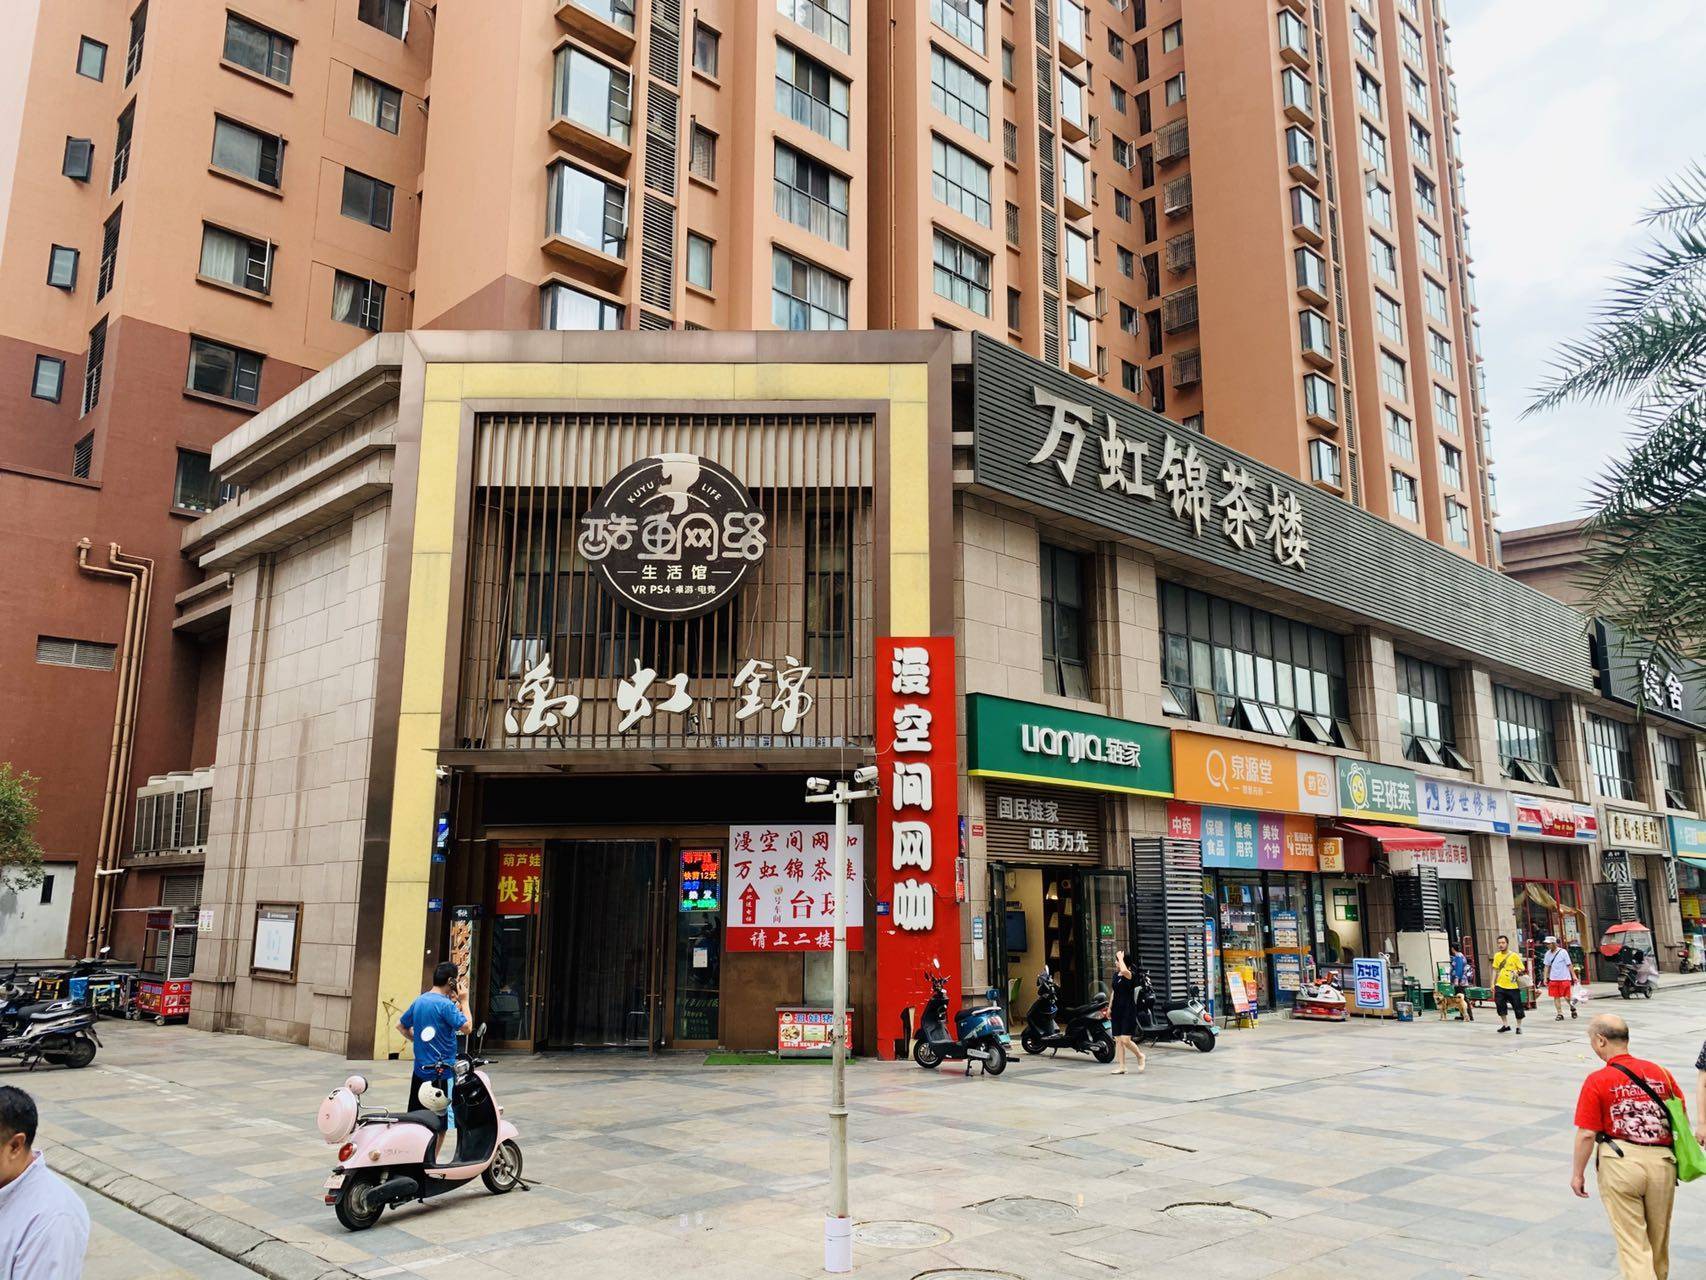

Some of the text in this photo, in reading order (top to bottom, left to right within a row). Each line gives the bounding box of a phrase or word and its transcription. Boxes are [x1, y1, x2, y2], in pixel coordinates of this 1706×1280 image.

[1026, 385, 1310, 571] 万虹锦茶楼
[627, 482, 722, 504] KUYU LIFE
[577, 511, 768, 561] 酷鱼网络
[641, 564, 708, 581] 生活馆
[631, 585, 647, 595] VR
[1231, 754, 1274, 785] 泉源堂
[891, 646, 935, 931] 漫空间网咖
[1371, 778, 1412, 812] 早班菜
[997, 796, 1060, 823] 国民链家
[1444, 787, 1497, 818] 彭世修脚
[1172, 816, 1192, 835] 中药
[1205, 819, 1225, 836] 保健
[1234, 821, 1253, 839] 慢病
[1262, 823, 1280, 841] 美妆
[1029, 827, 1090, 853] 品质为先
[1206, 838, 1225, 857] 食品
[1235, 841, 1253, 858] 用药
[1323, 841, 1335, 855] 药
[503, 853, 541, 868] 葫芦娃
[1263, 843, 1281, 860] 个护
[1324, 856, 1336, 866] 24
[498, 875, 541, 903] 快剪
[749, 928, 834, 950] 请上二楼
